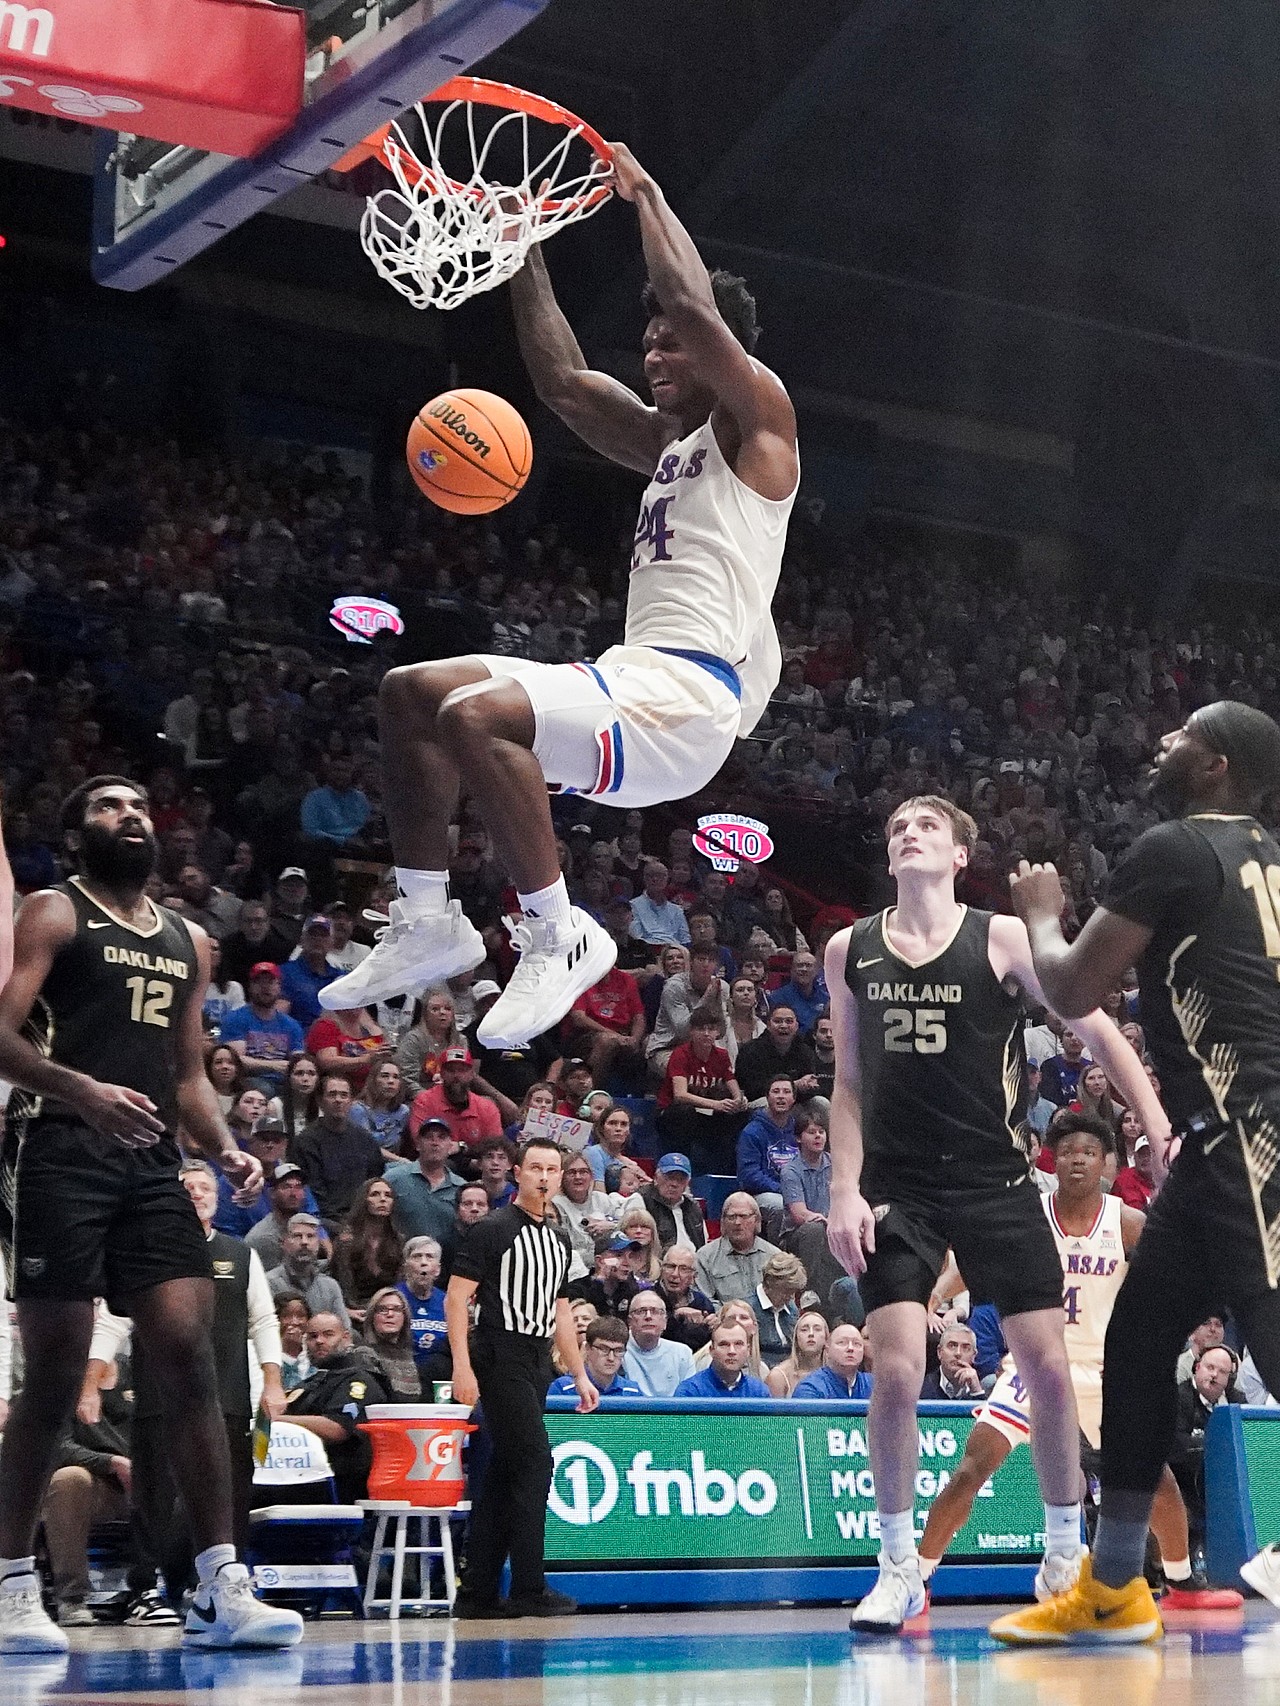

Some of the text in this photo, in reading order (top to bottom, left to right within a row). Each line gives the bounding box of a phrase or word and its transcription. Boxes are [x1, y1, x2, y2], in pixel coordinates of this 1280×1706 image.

[428, 400, 491, 459] Wilson
[707, 828, 761, 857] 810
[103, 946, 188, 979] OAKLAND
[126, 976, 173, 1028] 12
[867, 982, 962, 1003] OAKLAND
[883, 1008, 947, 1053] 25
[1066, 1254, 1118, 1276] NSAS
[1061, 1286, 1082, 1325] 4
[428, 1435, 454, 1465] G
[627, 1450, 778, 1516] fnbo
